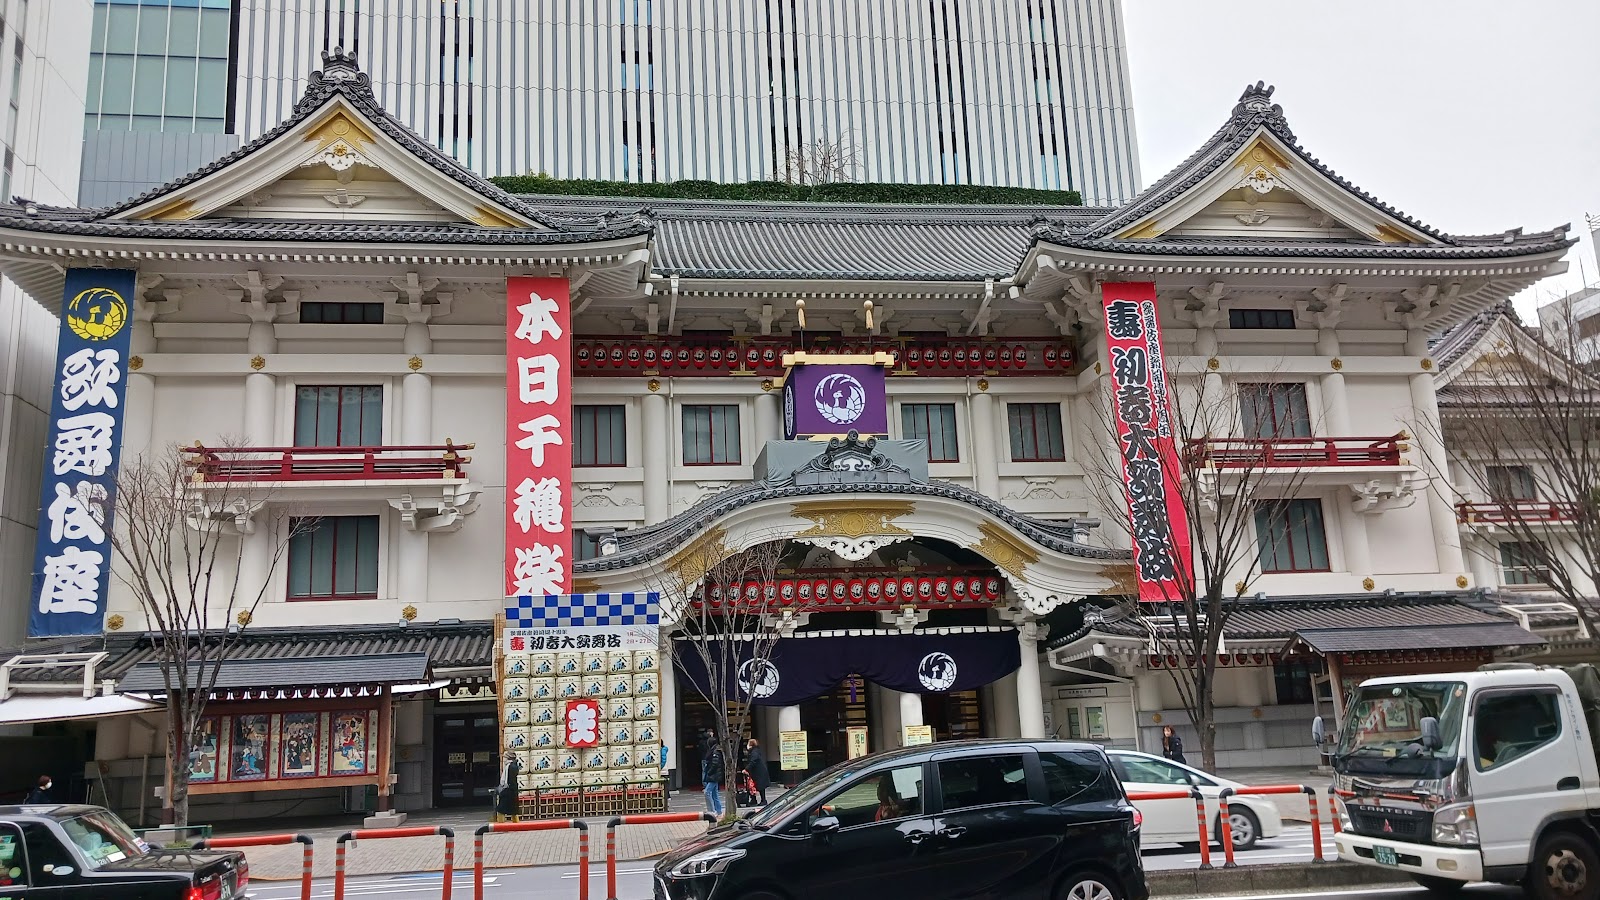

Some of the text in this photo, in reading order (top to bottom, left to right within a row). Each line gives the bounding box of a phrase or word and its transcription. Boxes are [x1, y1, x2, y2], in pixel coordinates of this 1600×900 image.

[38, 348, 121, 615] 歌舞伎座
[1359, 805, 1413, 815] CANTER
